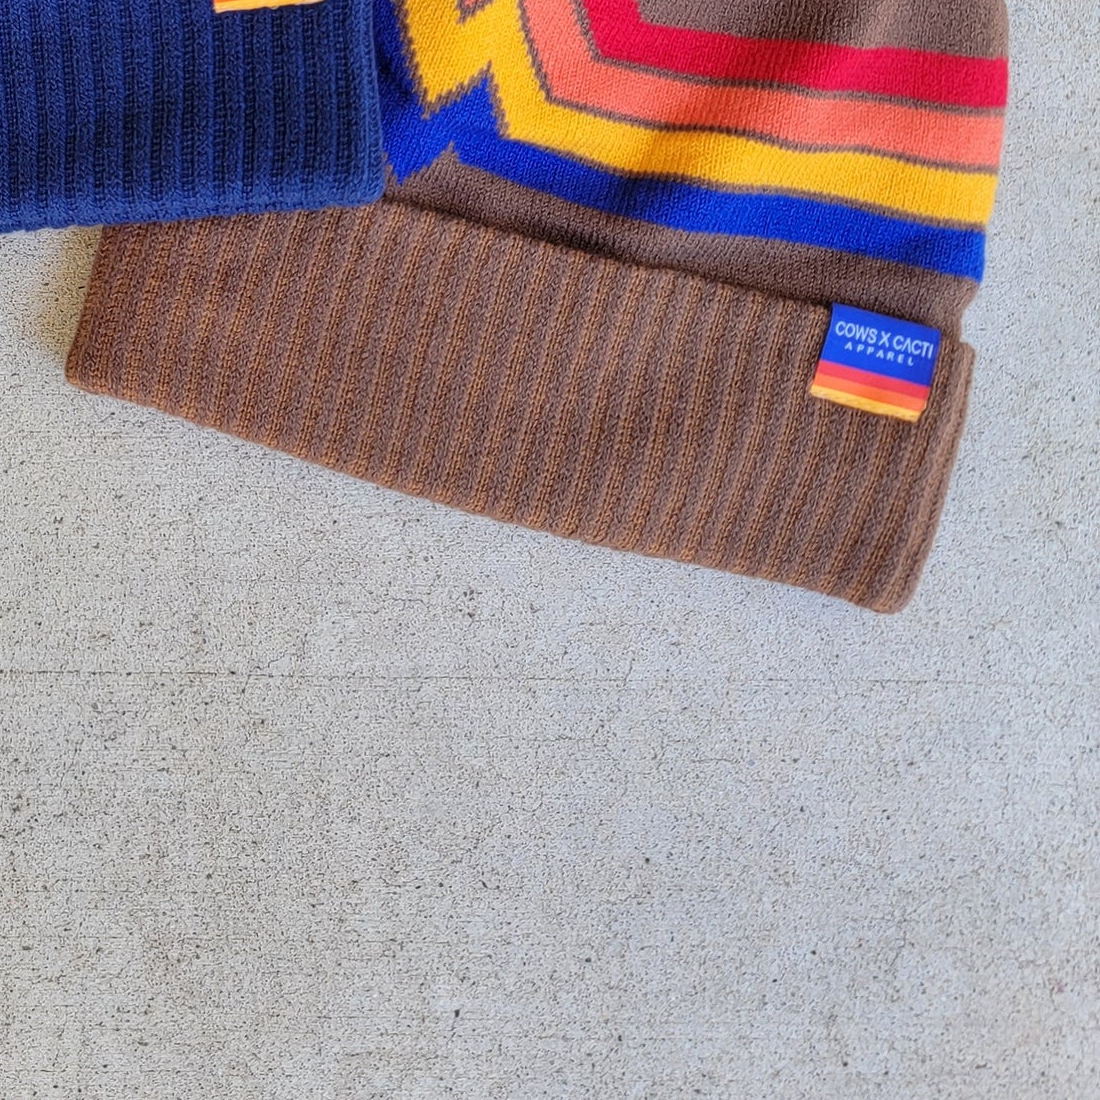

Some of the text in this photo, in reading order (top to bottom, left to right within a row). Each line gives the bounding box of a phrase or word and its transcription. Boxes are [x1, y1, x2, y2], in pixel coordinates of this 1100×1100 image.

[835, 321, 934, 360] COWS X CACTI
[844, 341, 914, 367] APPAREL
